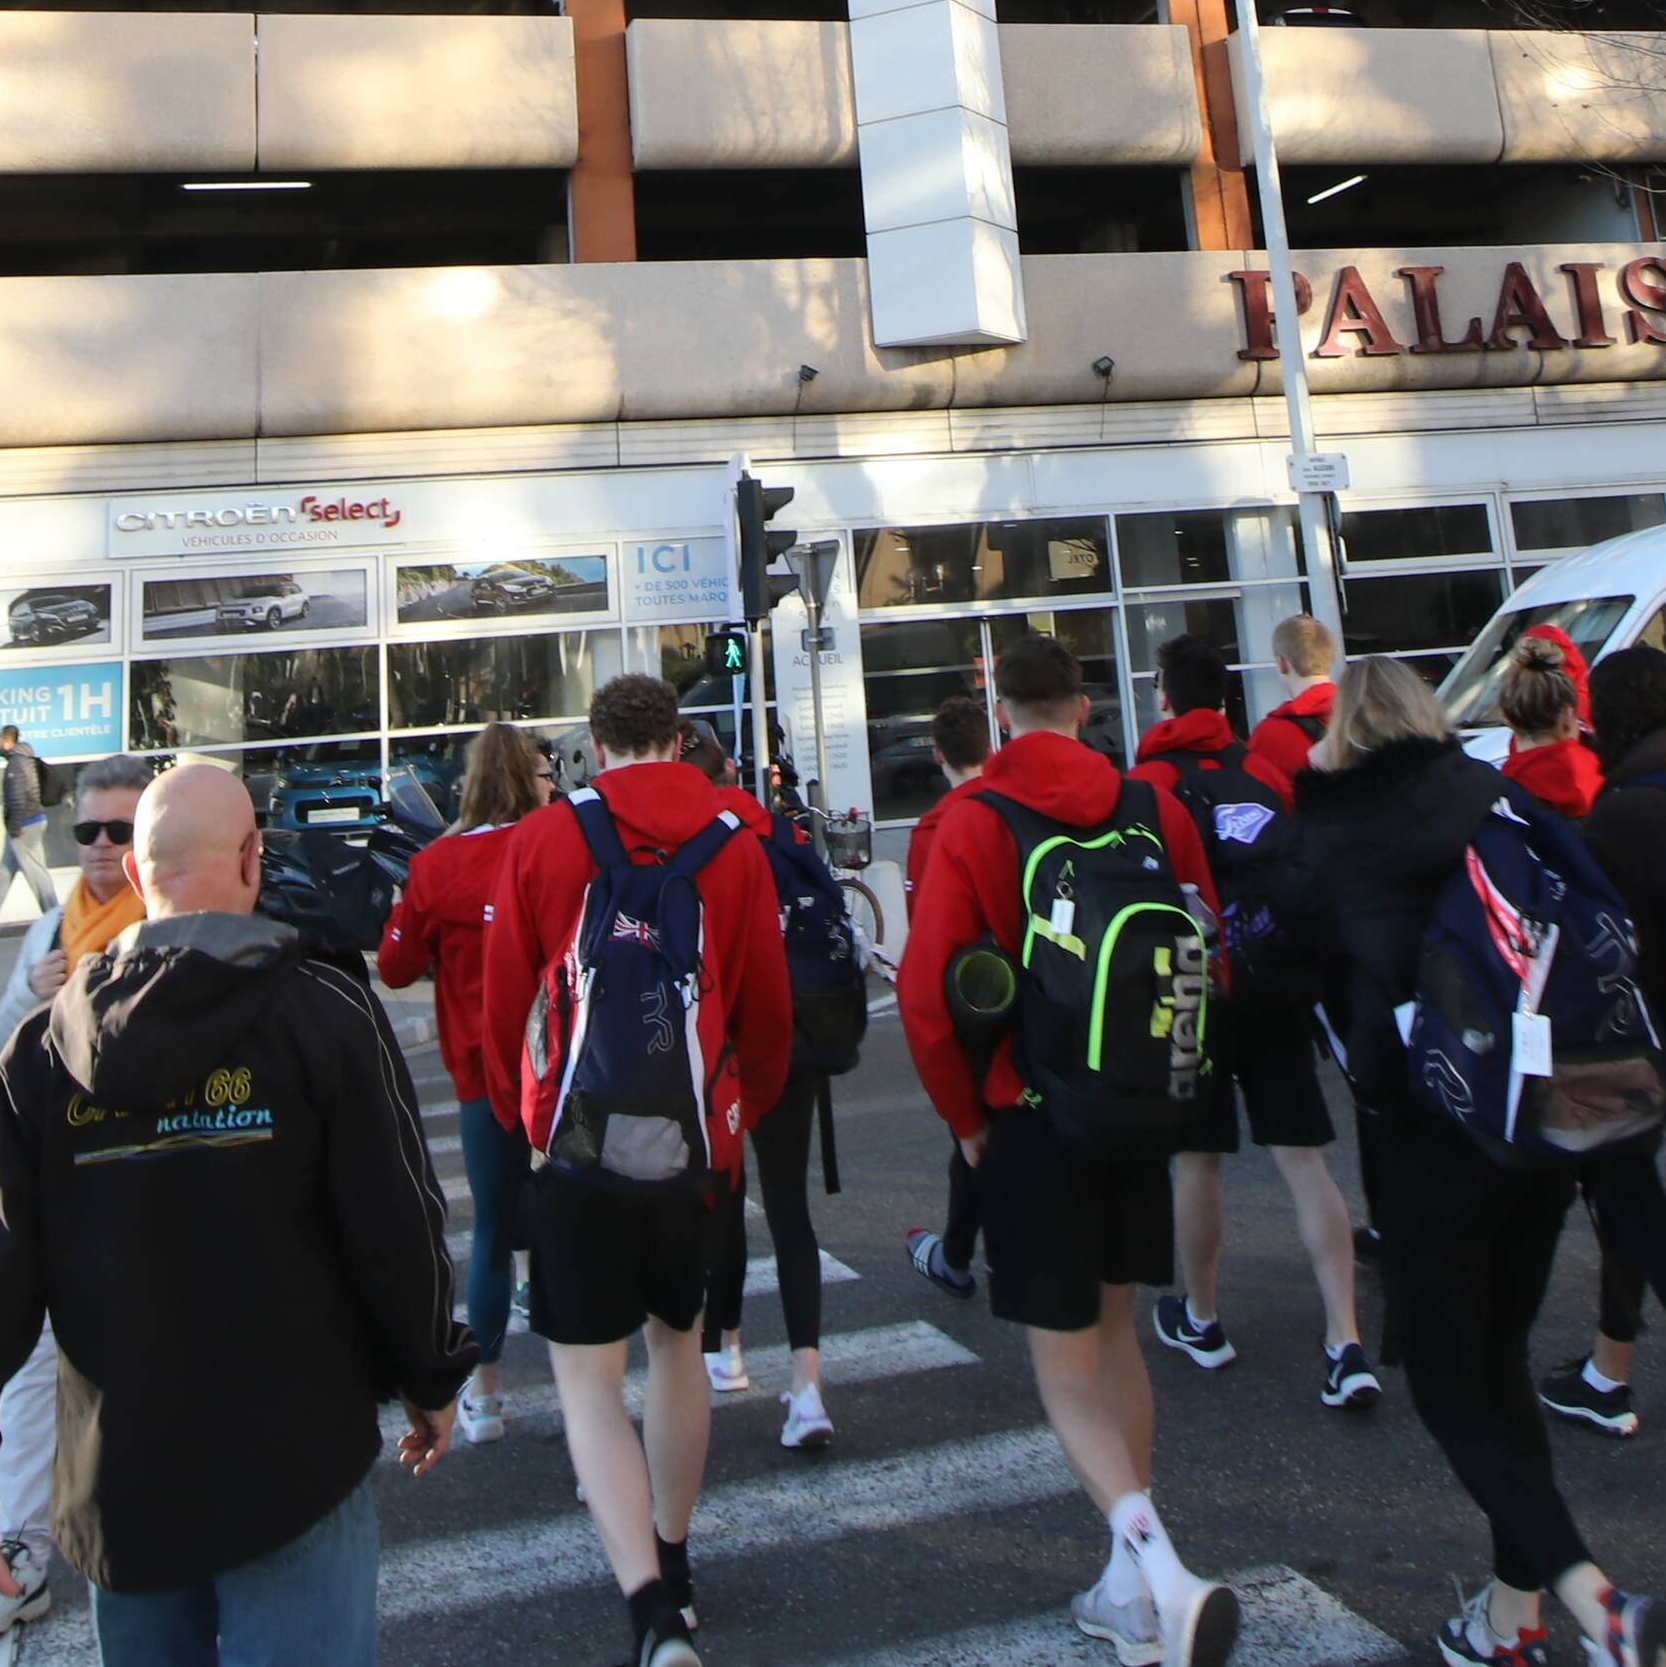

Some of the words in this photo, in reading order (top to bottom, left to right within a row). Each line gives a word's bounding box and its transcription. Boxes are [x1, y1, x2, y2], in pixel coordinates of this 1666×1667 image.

[309, 496, 391, 523] select
[636, 544, 691, 574] ICI
[644, 581, 662, 592] DE
[665, 579, 689, 591] 500
[635, 594, 686, 607] TOUTES
[792, 652, 844, 667] ACUEIL
[57, 681, 113, 721] 1H
[18, 729, 49, 743] OTRE
[639, 981, 675, 1056] TYR
[204, 1066, 252, 1107] 66
